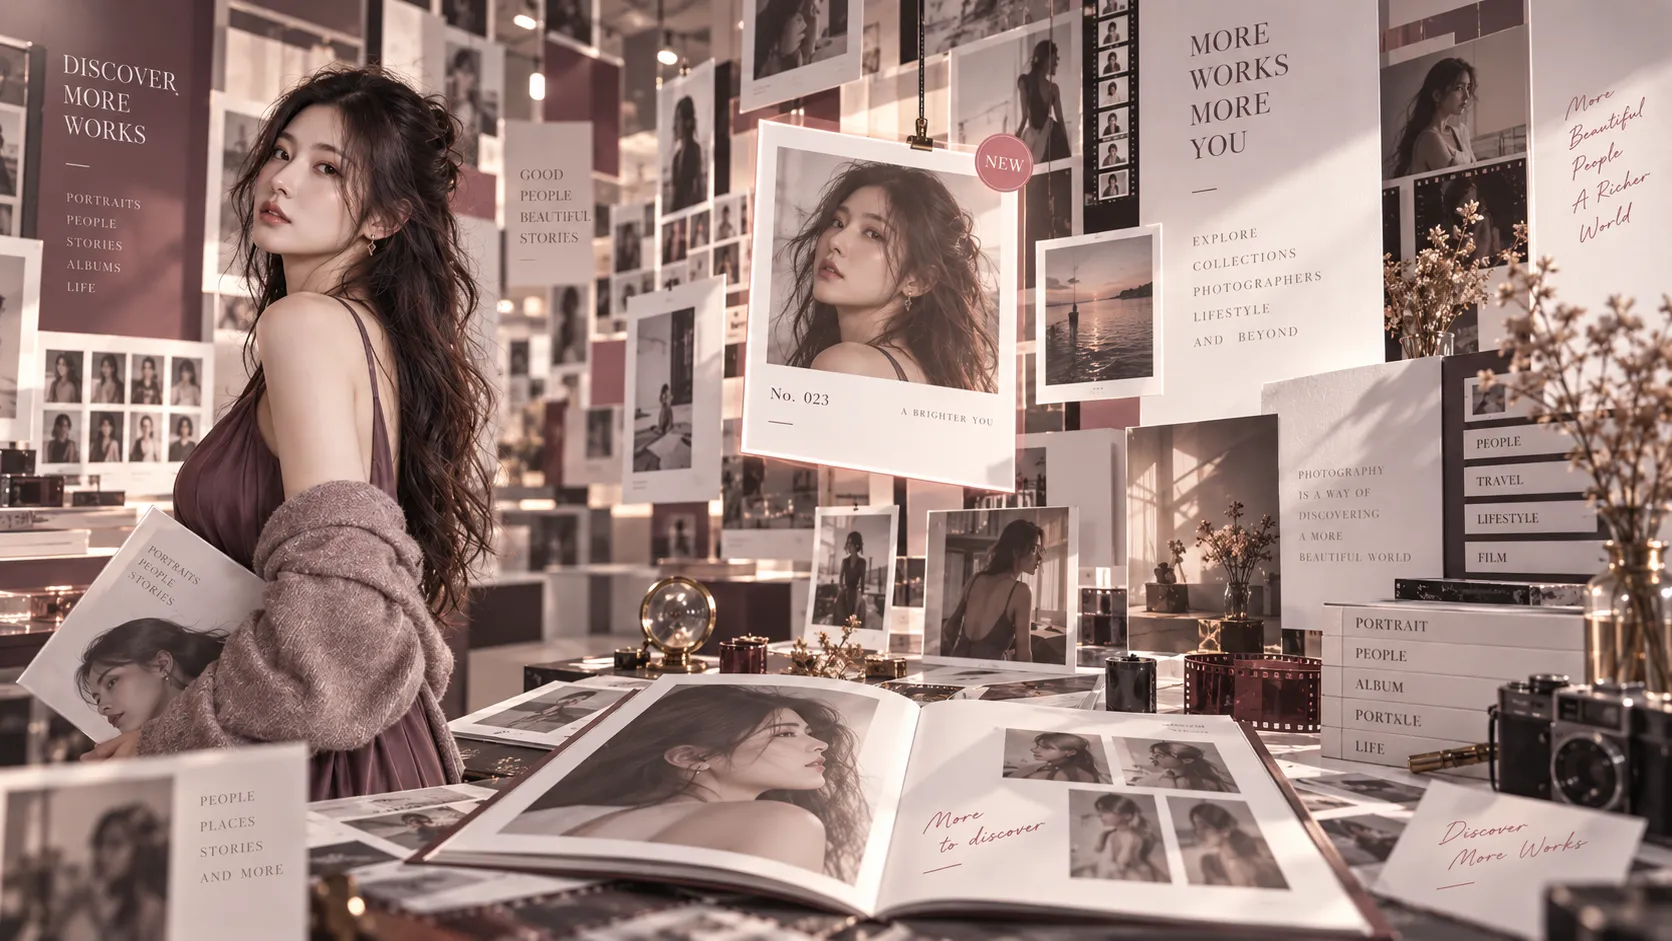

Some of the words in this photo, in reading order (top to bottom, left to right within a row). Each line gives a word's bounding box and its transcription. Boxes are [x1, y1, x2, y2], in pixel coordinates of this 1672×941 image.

[1190, 22, 1270, 57] MORE
[1189, 53, 1289, 90] WORKS
[63, 85, 130, 112] MORE
[1564, 90, 1615, 121] More
[1190, 91, 1270, 126] MORE
[64, 115, 146, 144] WORKS
[1569, 96, 1646, 150] Beautiful
[1190, 130, 1248, 160] YOU
[985, 154, 1024, 172] NEW
[1572, 142, 1624, 181] People
[520, 169, 563, 181] GOOD
[520, 190, 572, 202] PEOPLE
[1572, 188, 1589, 214] A
[1597, 170, 1650, 204] Richer
[66, 193, 141, 210] PORTRAITS
[66, 215, 117, 229] PEOPLE
[520, 211, 591, 223] BEAUTIFUL
[1579, 202, 1632, 244] World
[66, 237, 123, 251] STORIES
[520, 232, 579, 244] STORIES
[1193, 228, 1258, 247] EXPLORE
[66, 260, 121, 273] ALBUMS
[1193, 247, 1297, 272] COLLECTIONS
[67, 282, 96, 293] LIFE
[1193, 271, 1323, 297] PHOTOGRAPHERS
[1193, 303, 1271, 323] LIFESTYLE
[1193, 333, 1224, 348] AND
[1238, 326, 1299, 343] BEYOND
[770, 387, 796, 402] No.
[804, 391, 830, 406] 023
[901, 408, 907, 416] A
[913, 409, 967, 423] BRIGHTER
[972, 416, 994, 426] YOU
[1476, 436, 1522, 450] PEOPLE
[1298, 465, 1384, 480] PHOTOGRAPHY
[1476, 475, 1524, 488] TRAVEL
[1299, 491, 1309, 500] IS
[1314, 490, 1321, 499] A
[1326, 489, 1350, 499] WAY
[1355, 487, 1371, 498] OF
[1299, 508, 1380, 520] DISCOVERING
[1477, 512, 1539, 525] LIFESTYLE
[1299, 532, 1307, 541] A
[1310, 531, 1343, 542] MORE
[148, 545, 201, 586] PORTRAITS
[1299, 552, 1362, 563] BEAUTIFUL
[1367, 552, 1412, 563] WORLD
[1478, 552, 1507, 564] FILM
[138, 558, 176, 588] PEOPLE
[128, 571, 176, 607] STORIES
[1355, 617, 1428, 633] PORTRAIT
[1355, 647, 1407, 662] PEOPLE
[1355, 678, 1404, 694] ALBUM
[1355, 740, 1385, 755] LIFE
[200, 790, 256, 807] PEOPLE
[200, 816, 256, 832] PLACES
[922, 811, 984, 835] More
[939, 836, 958, 854] to
[968, 821, 1045, 846] discover
[1438, 820, 1529, 846] Discover
[200, 840, 264, 858] STORIES
[1447, 848, 1508, 871] More
[1519, 831, 1588, 859] Works
[200, 870, 232, 884] AND
[240, 863, 284, 879] MORE
